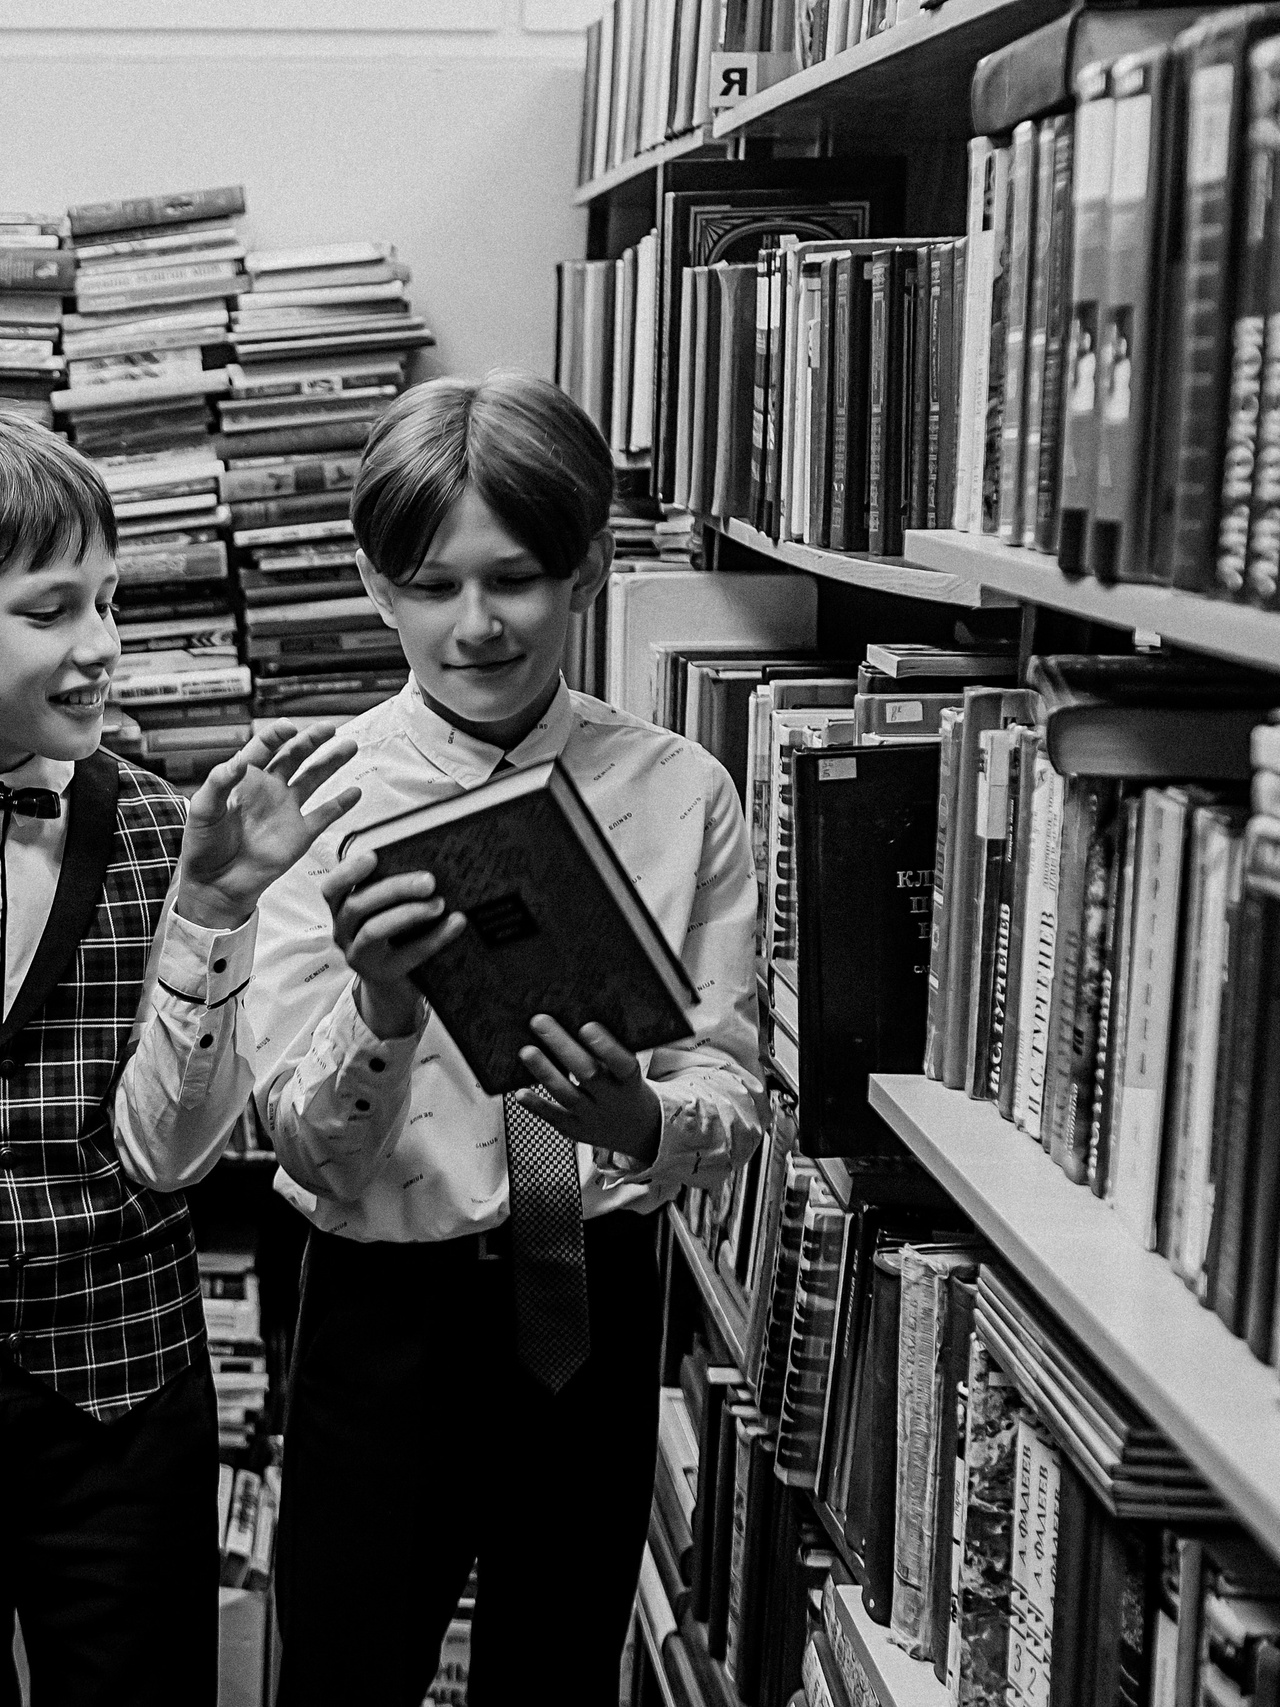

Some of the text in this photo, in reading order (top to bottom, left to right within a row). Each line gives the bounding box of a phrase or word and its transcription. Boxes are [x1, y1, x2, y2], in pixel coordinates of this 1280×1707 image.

[720, 67, 748, 97] Я
[660, 747, 684, 766] GENIUS
[608, 812, 633, 831] GENIUS
[304, 963, 330, 983] GENIUS
[992, 903, 1010, 1034] ТУРГЕНЕВ
[1032, 911, 1054, 1055] ТУРГЕНЕВ
[1018, 1443, 1032, 1567] А. ФАДЕЕВ
[1033, 1465, 1050, 1588] А. ФАДЕЕВ
[1013, 1643, 1022, 1672] 3
[1027, 1667, 1038, 1696] 2
